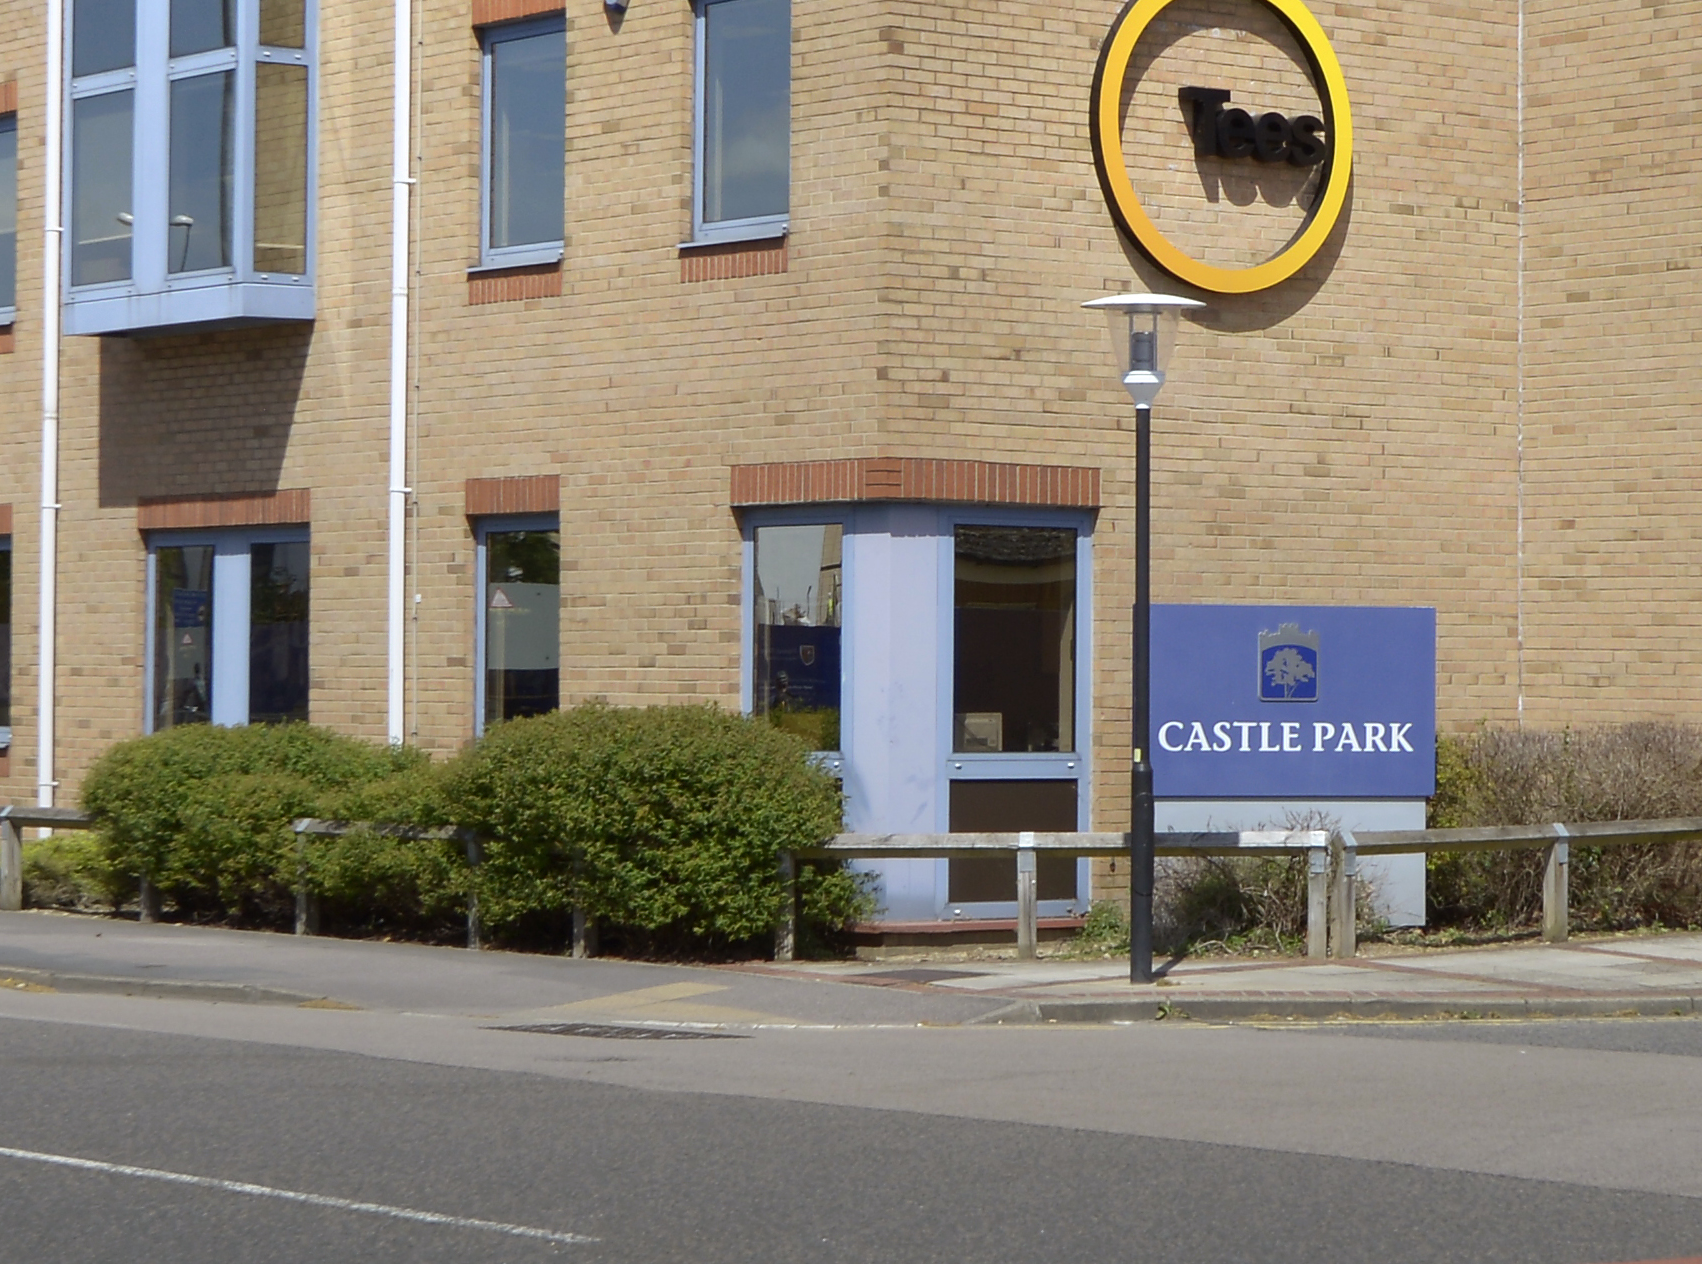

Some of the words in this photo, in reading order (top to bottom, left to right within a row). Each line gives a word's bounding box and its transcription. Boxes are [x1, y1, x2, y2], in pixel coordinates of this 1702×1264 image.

[1178, 86, 1326, 167] Tees
[1157, 721, 1302, 753] CASTLE
[1312, 722, 1414, 753] PARK
